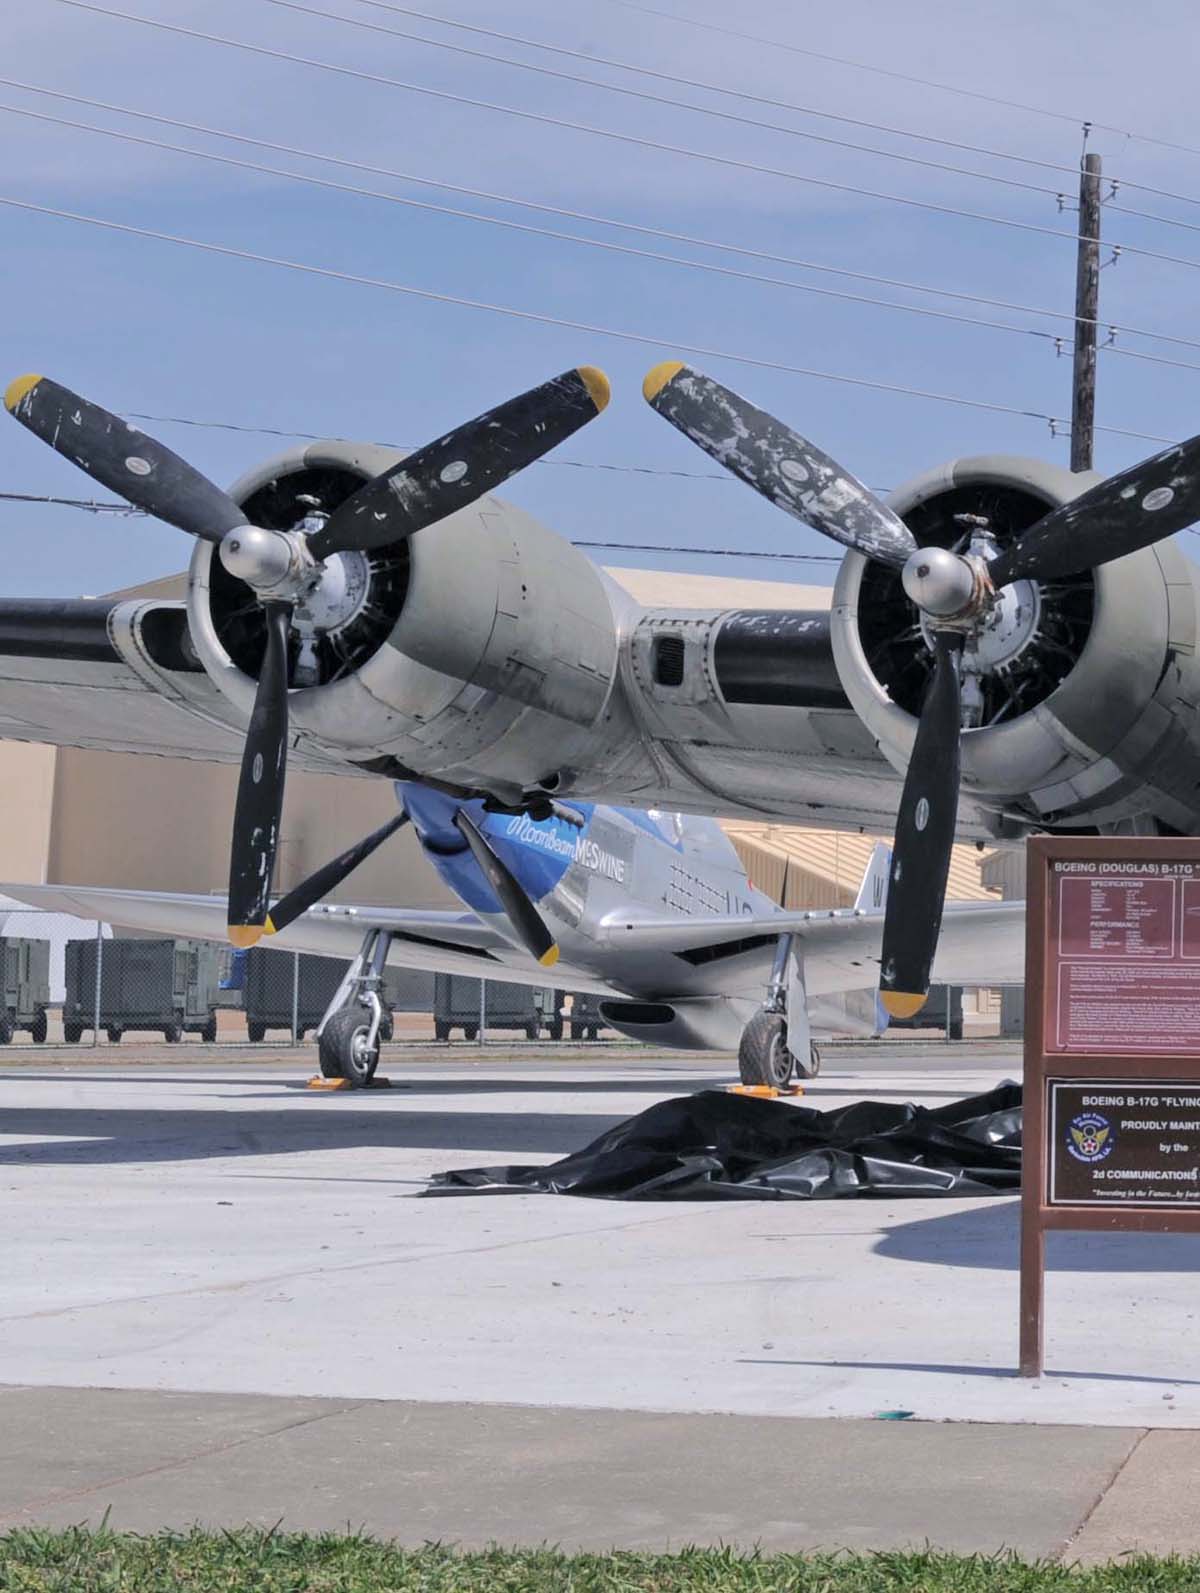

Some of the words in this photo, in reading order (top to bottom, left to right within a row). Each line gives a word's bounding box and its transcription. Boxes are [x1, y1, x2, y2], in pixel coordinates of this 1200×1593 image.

[506, 815, 576, 858] Moonbeam
[1054, 862, 1096, 872] BOEING
[1099, 863, 1159, 874] (DOUGLAS)
[1161, 864, 1193, 874] B-17G
[1090, 920, 1140, 928] PERFORMANCE
[1082, 1096, 1125, 1107] BOEING
[1127, 1097, 1159, 1107] B-17G
[1121, 1120, 1168, 1131] PROUDLY
[1159, 1143, 1171, 1153] by
[1173, 1143, 1189, 1153] the
[1092, 1170, 1105, 1179] 2d
[1106, 1170, 1198, 1181] COMMUNICATIONS
